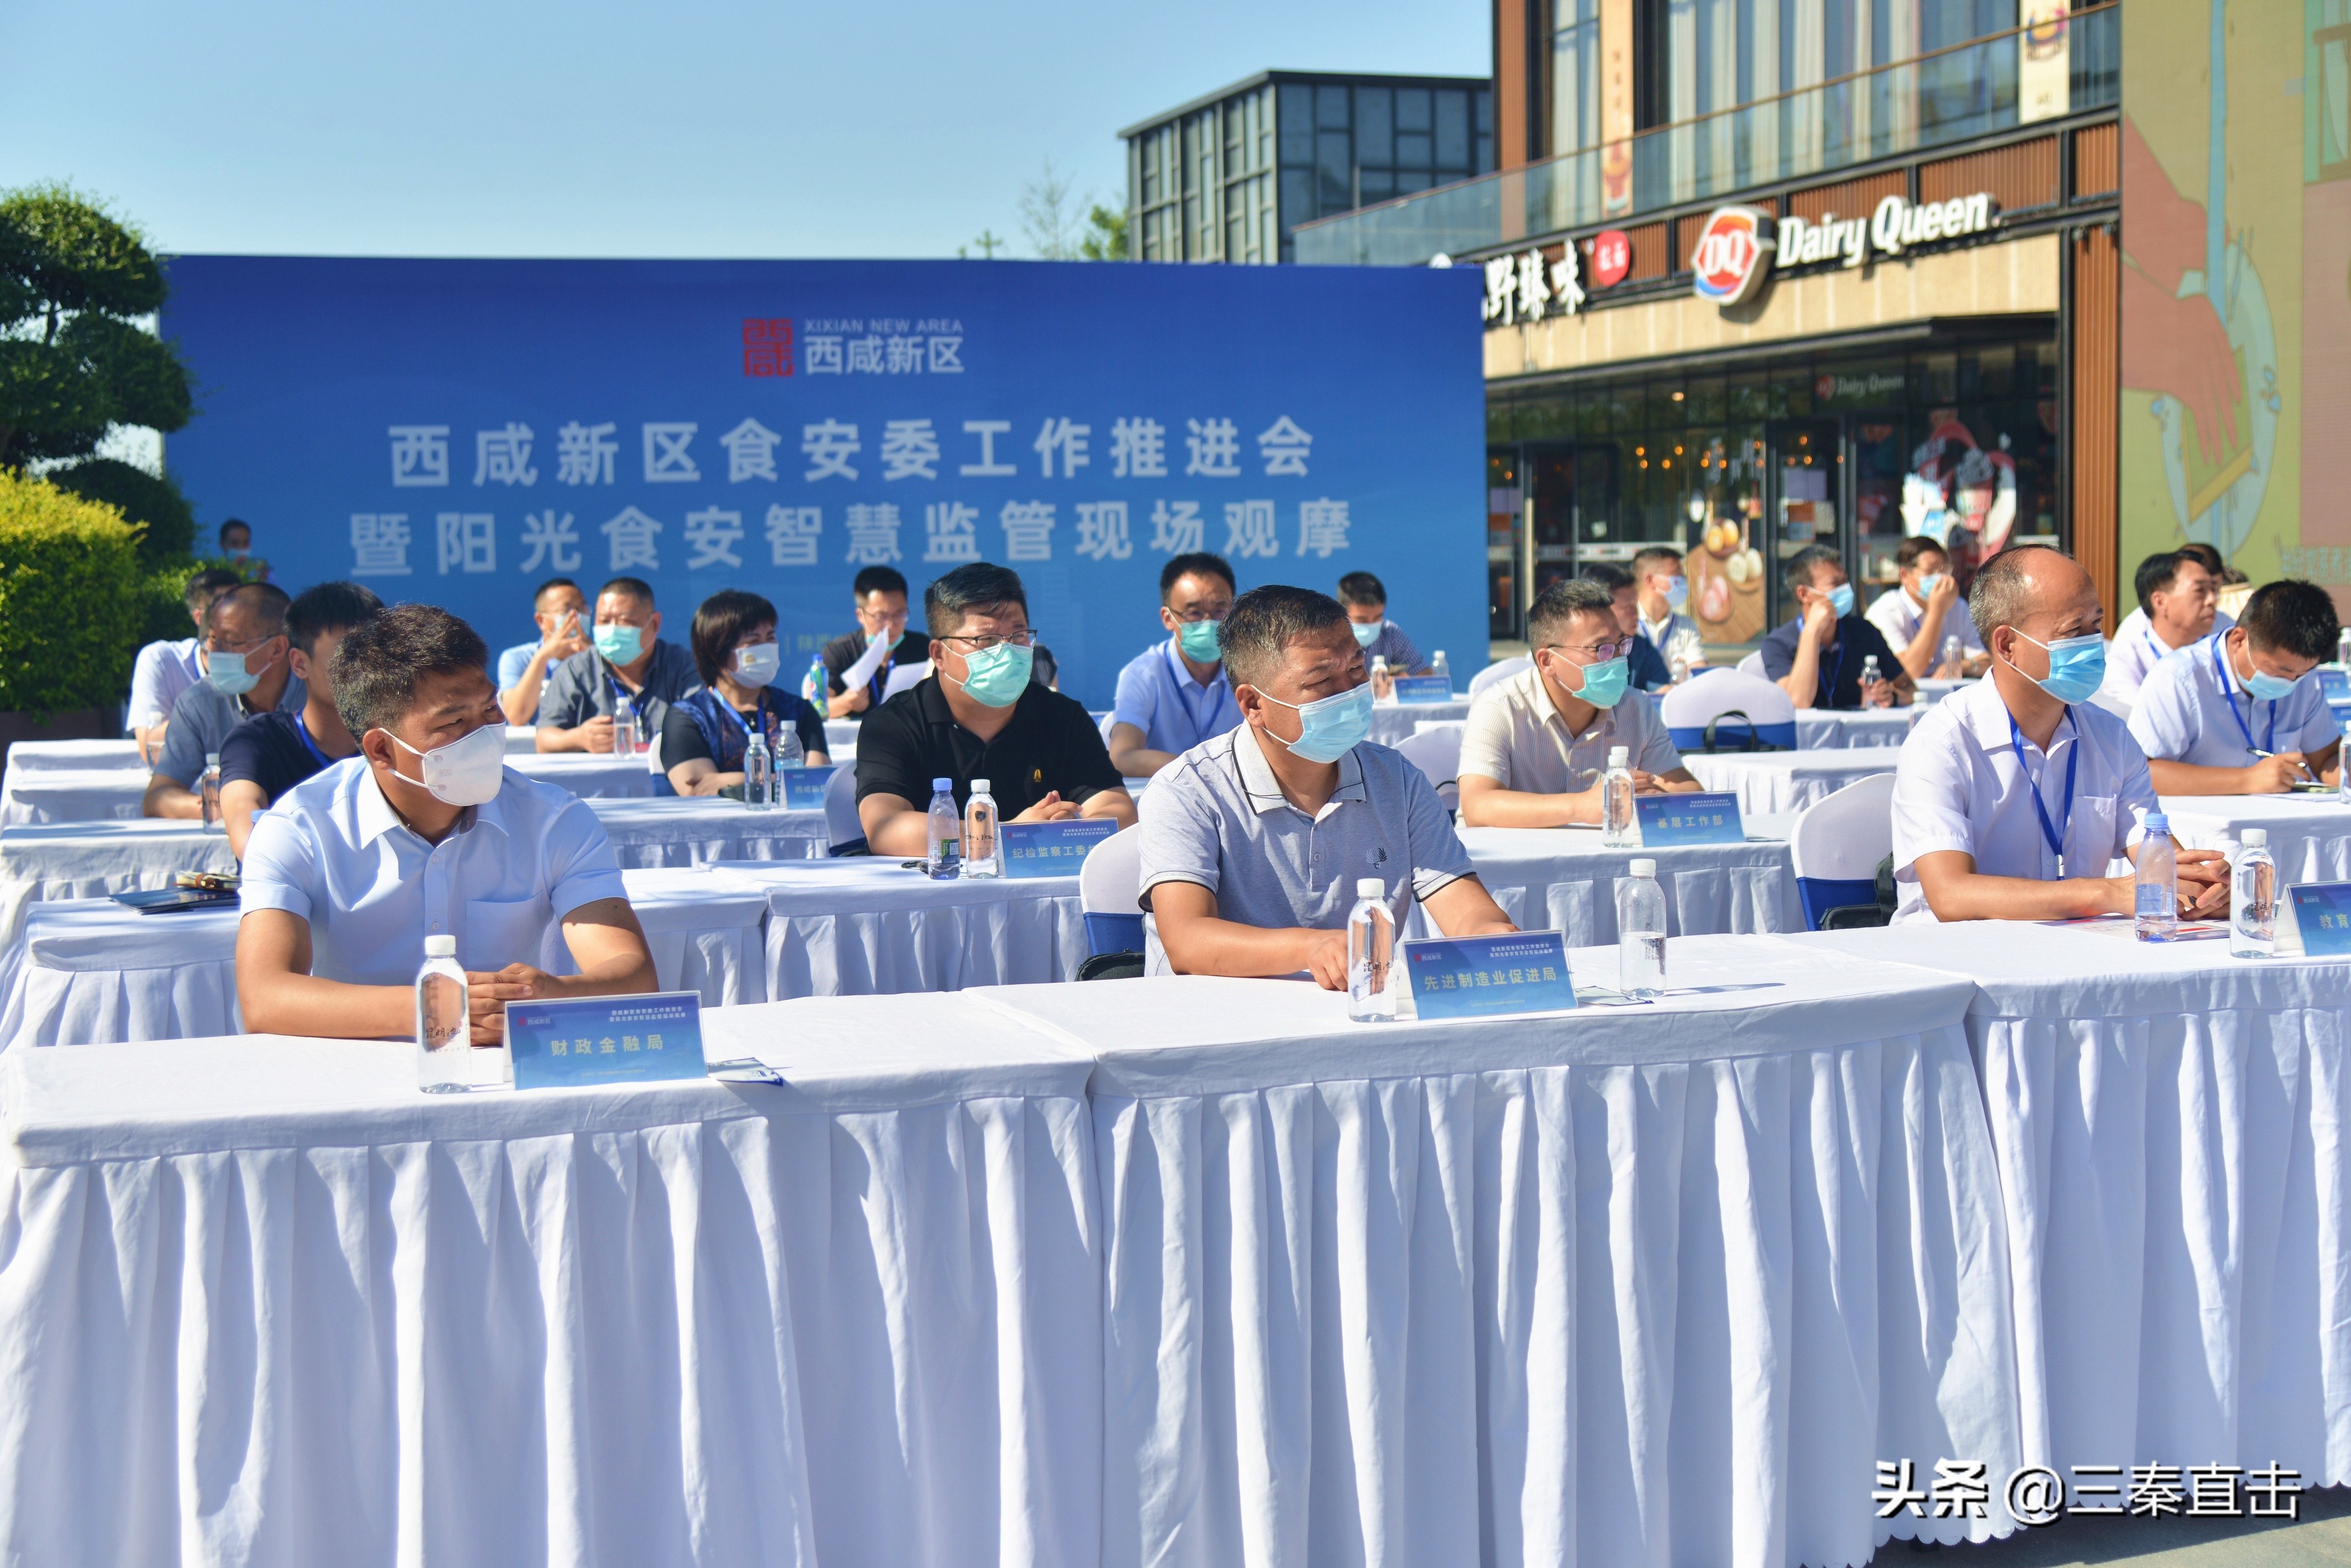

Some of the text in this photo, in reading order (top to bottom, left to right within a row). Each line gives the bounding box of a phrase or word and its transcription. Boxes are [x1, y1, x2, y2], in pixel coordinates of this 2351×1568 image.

[1776, 192, 1990, 268] Dairy Queen
[1702, 229, 1748, 278] DQ
[805, 318, 964, 333] XIXIAN NEW AREA
[804, 334, 964, 375] 西咸新区
[388, 415, 1313, 487] 西咸新区食安委工作推进会
[351, 498, 1350, 576] 暨阳光食安智慧监管现场观摩
[1658, 815, 1723, 828] 基层工作部
[2319, 913, 2349, 929] 教育
[1425, 967, 1557, 991] 先进制造业促进局
[550, 1034, 663, 1056] 财政金融局
